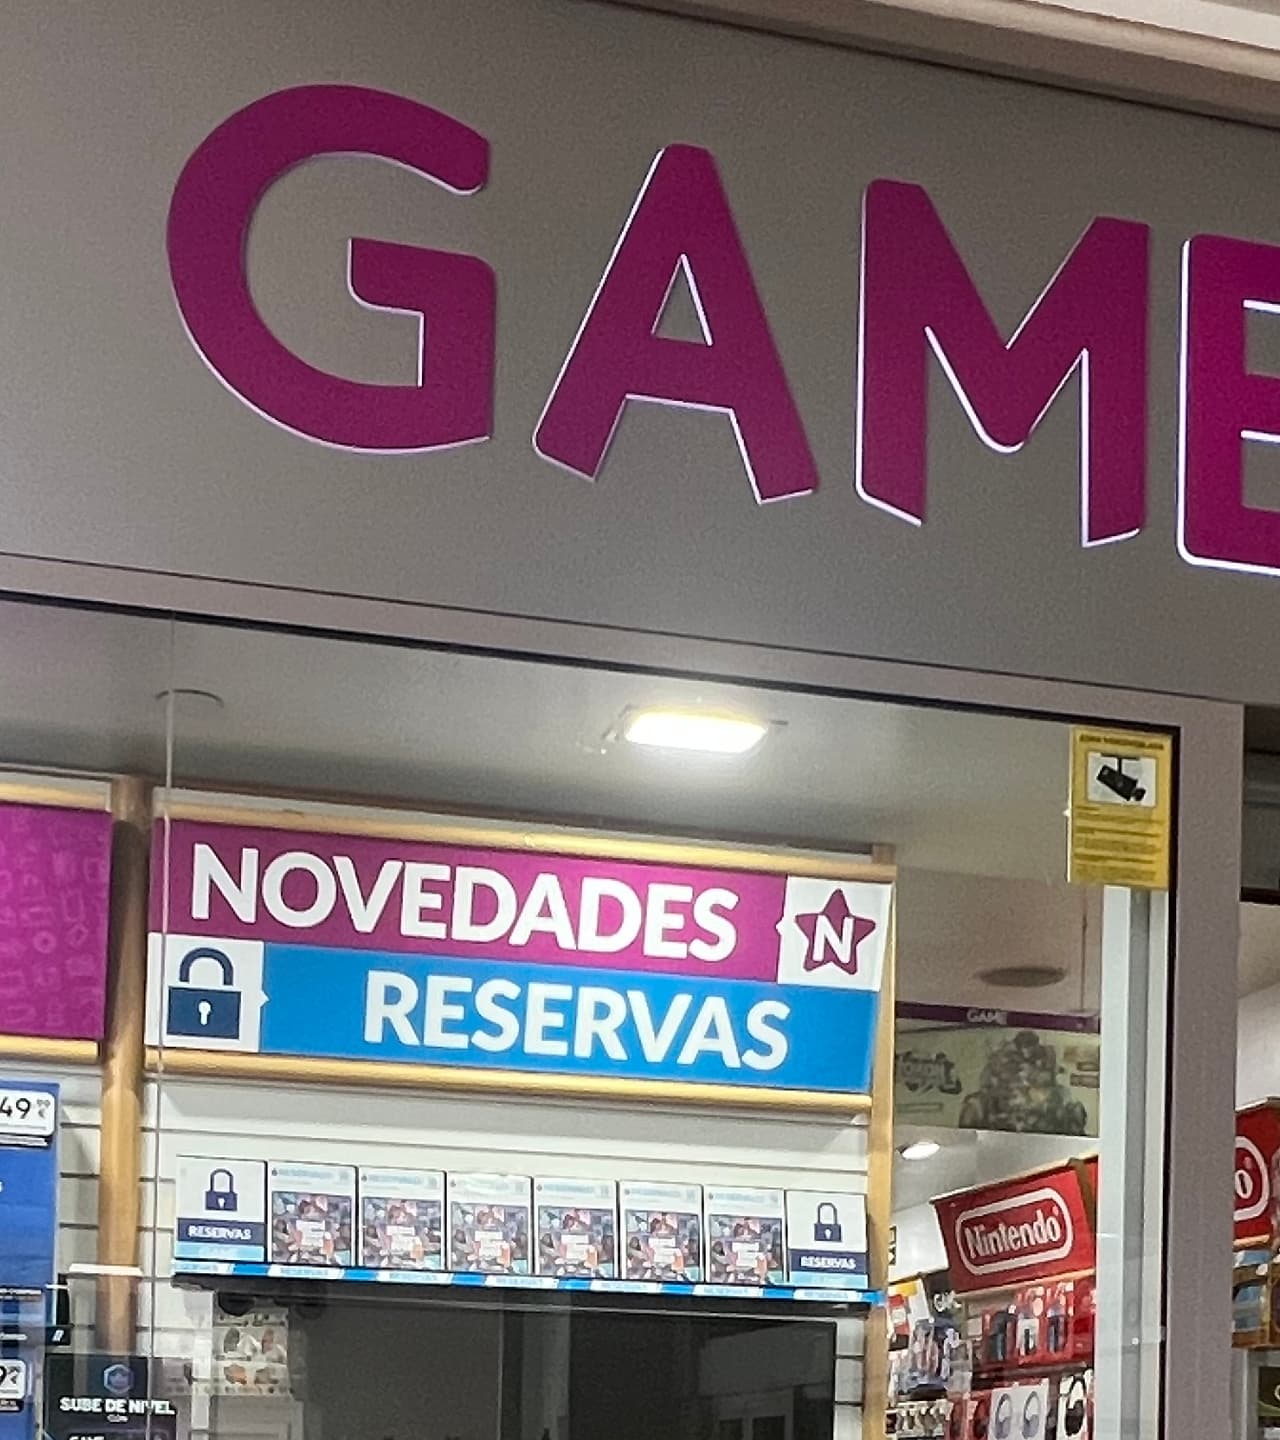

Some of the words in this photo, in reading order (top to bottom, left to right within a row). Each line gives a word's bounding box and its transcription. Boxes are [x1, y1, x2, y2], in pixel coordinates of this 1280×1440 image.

[191, 842, 739, 962] NOVEDADES
[811, 913, 856, 966] N
[363, 970, 791, 1072] RESERVAS
[187, 1224, 252, 1240] RESERVAS
[965, 1209, 1061, 1261] Nintendo
[800, 1255, 857, 1270] RESERVAS
[59, 1396, 103, 1413] SUBE
[105, 1398, 128, 1414] DE
[130, 1399, 176, 1416] NIVEL
